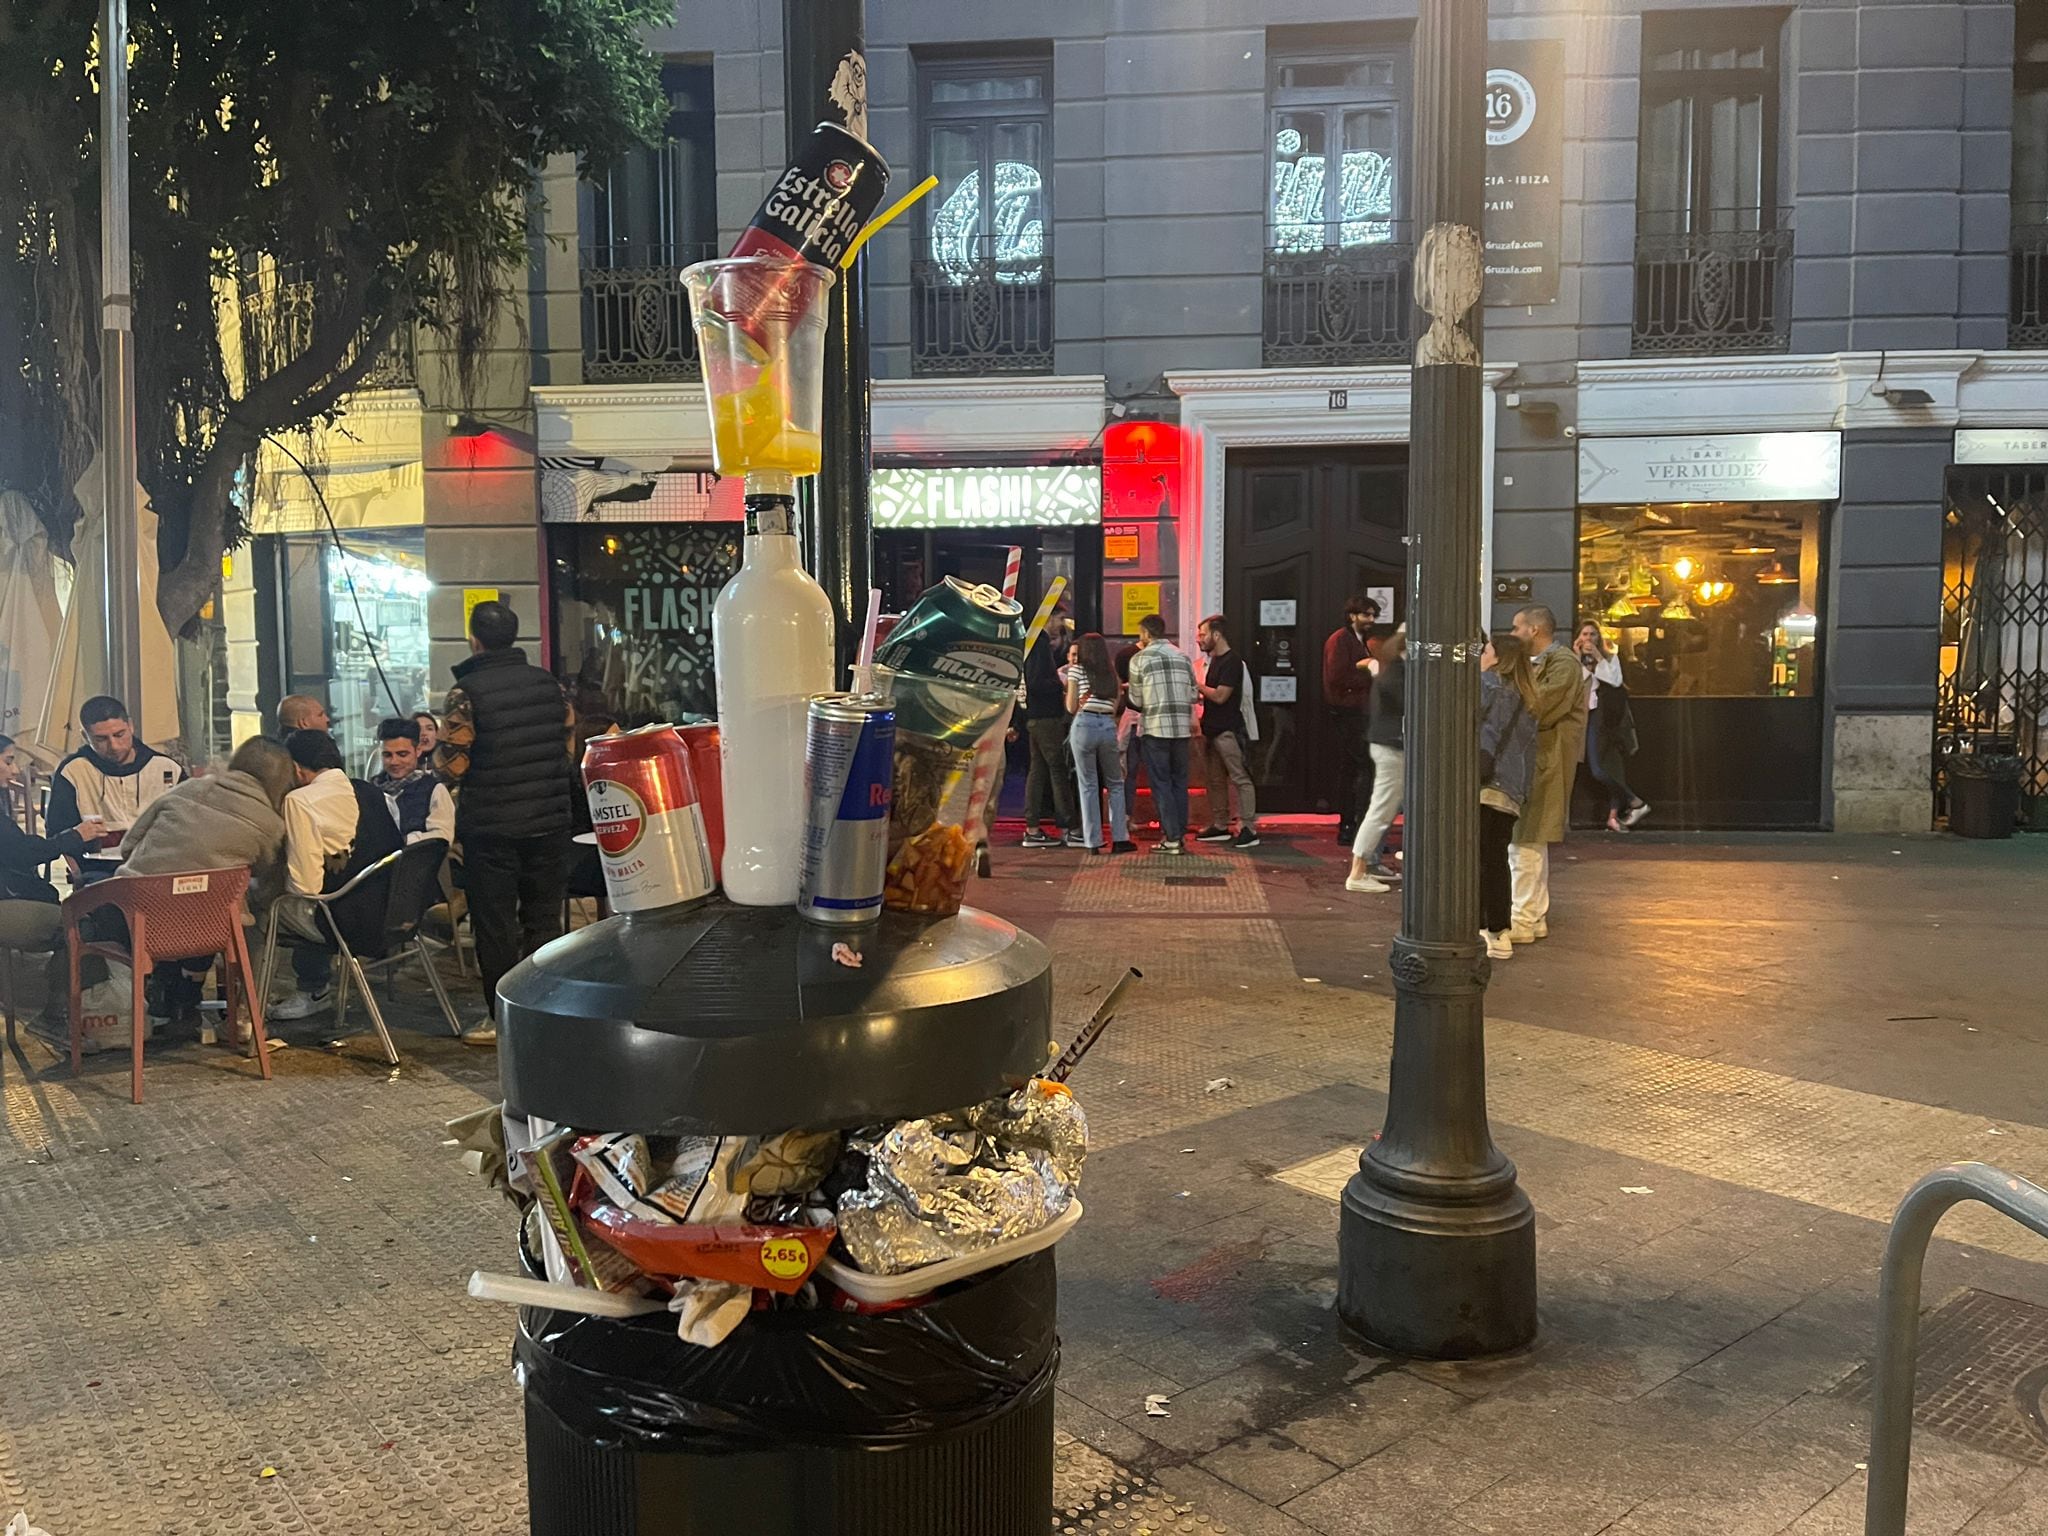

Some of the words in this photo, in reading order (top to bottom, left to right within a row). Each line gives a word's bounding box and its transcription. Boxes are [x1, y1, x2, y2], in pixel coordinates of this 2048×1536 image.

[1486, 93, 1512, 118] 16
[1516, 174, 1550, 185] IBIZA
[777, 166, 859, 242] Estrella
[765, 190, 842, 264] Galicia
[1331, 391, 1346, 408] 16
[1693, 450, 1723, 459] BAR
[926, 474, 1033, 519] FLASH!
[624, 587, 720, 630] FLASH
[617, 859, 645, 878] MALTA
